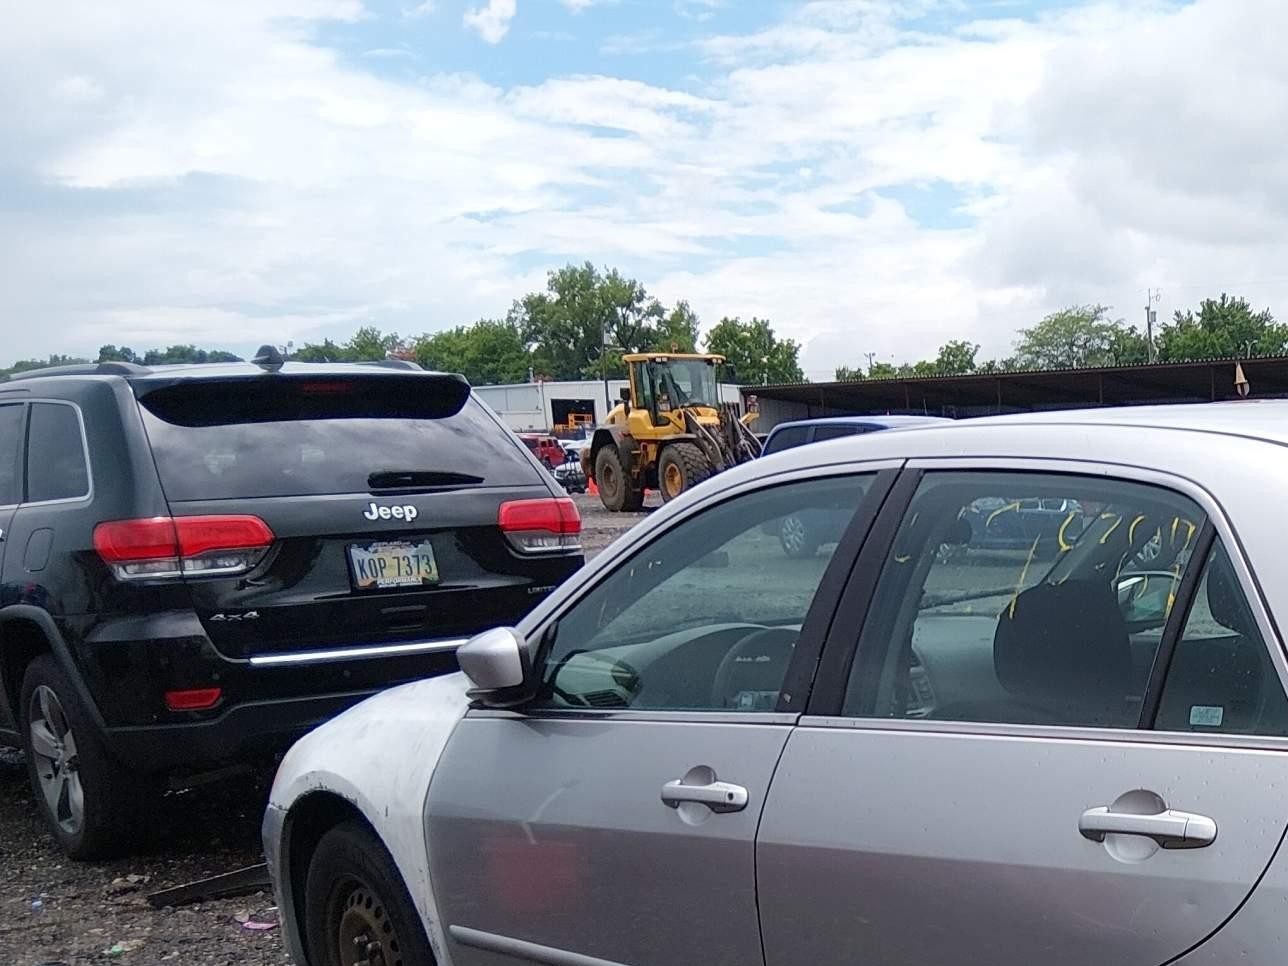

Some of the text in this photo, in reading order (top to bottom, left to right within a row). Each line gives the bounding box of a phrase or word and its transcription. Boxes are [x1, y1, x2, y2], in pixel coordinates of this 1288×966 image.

[363, 503, 418, 522] Jeep
[357, 553, 433, 580] KOP 7373
